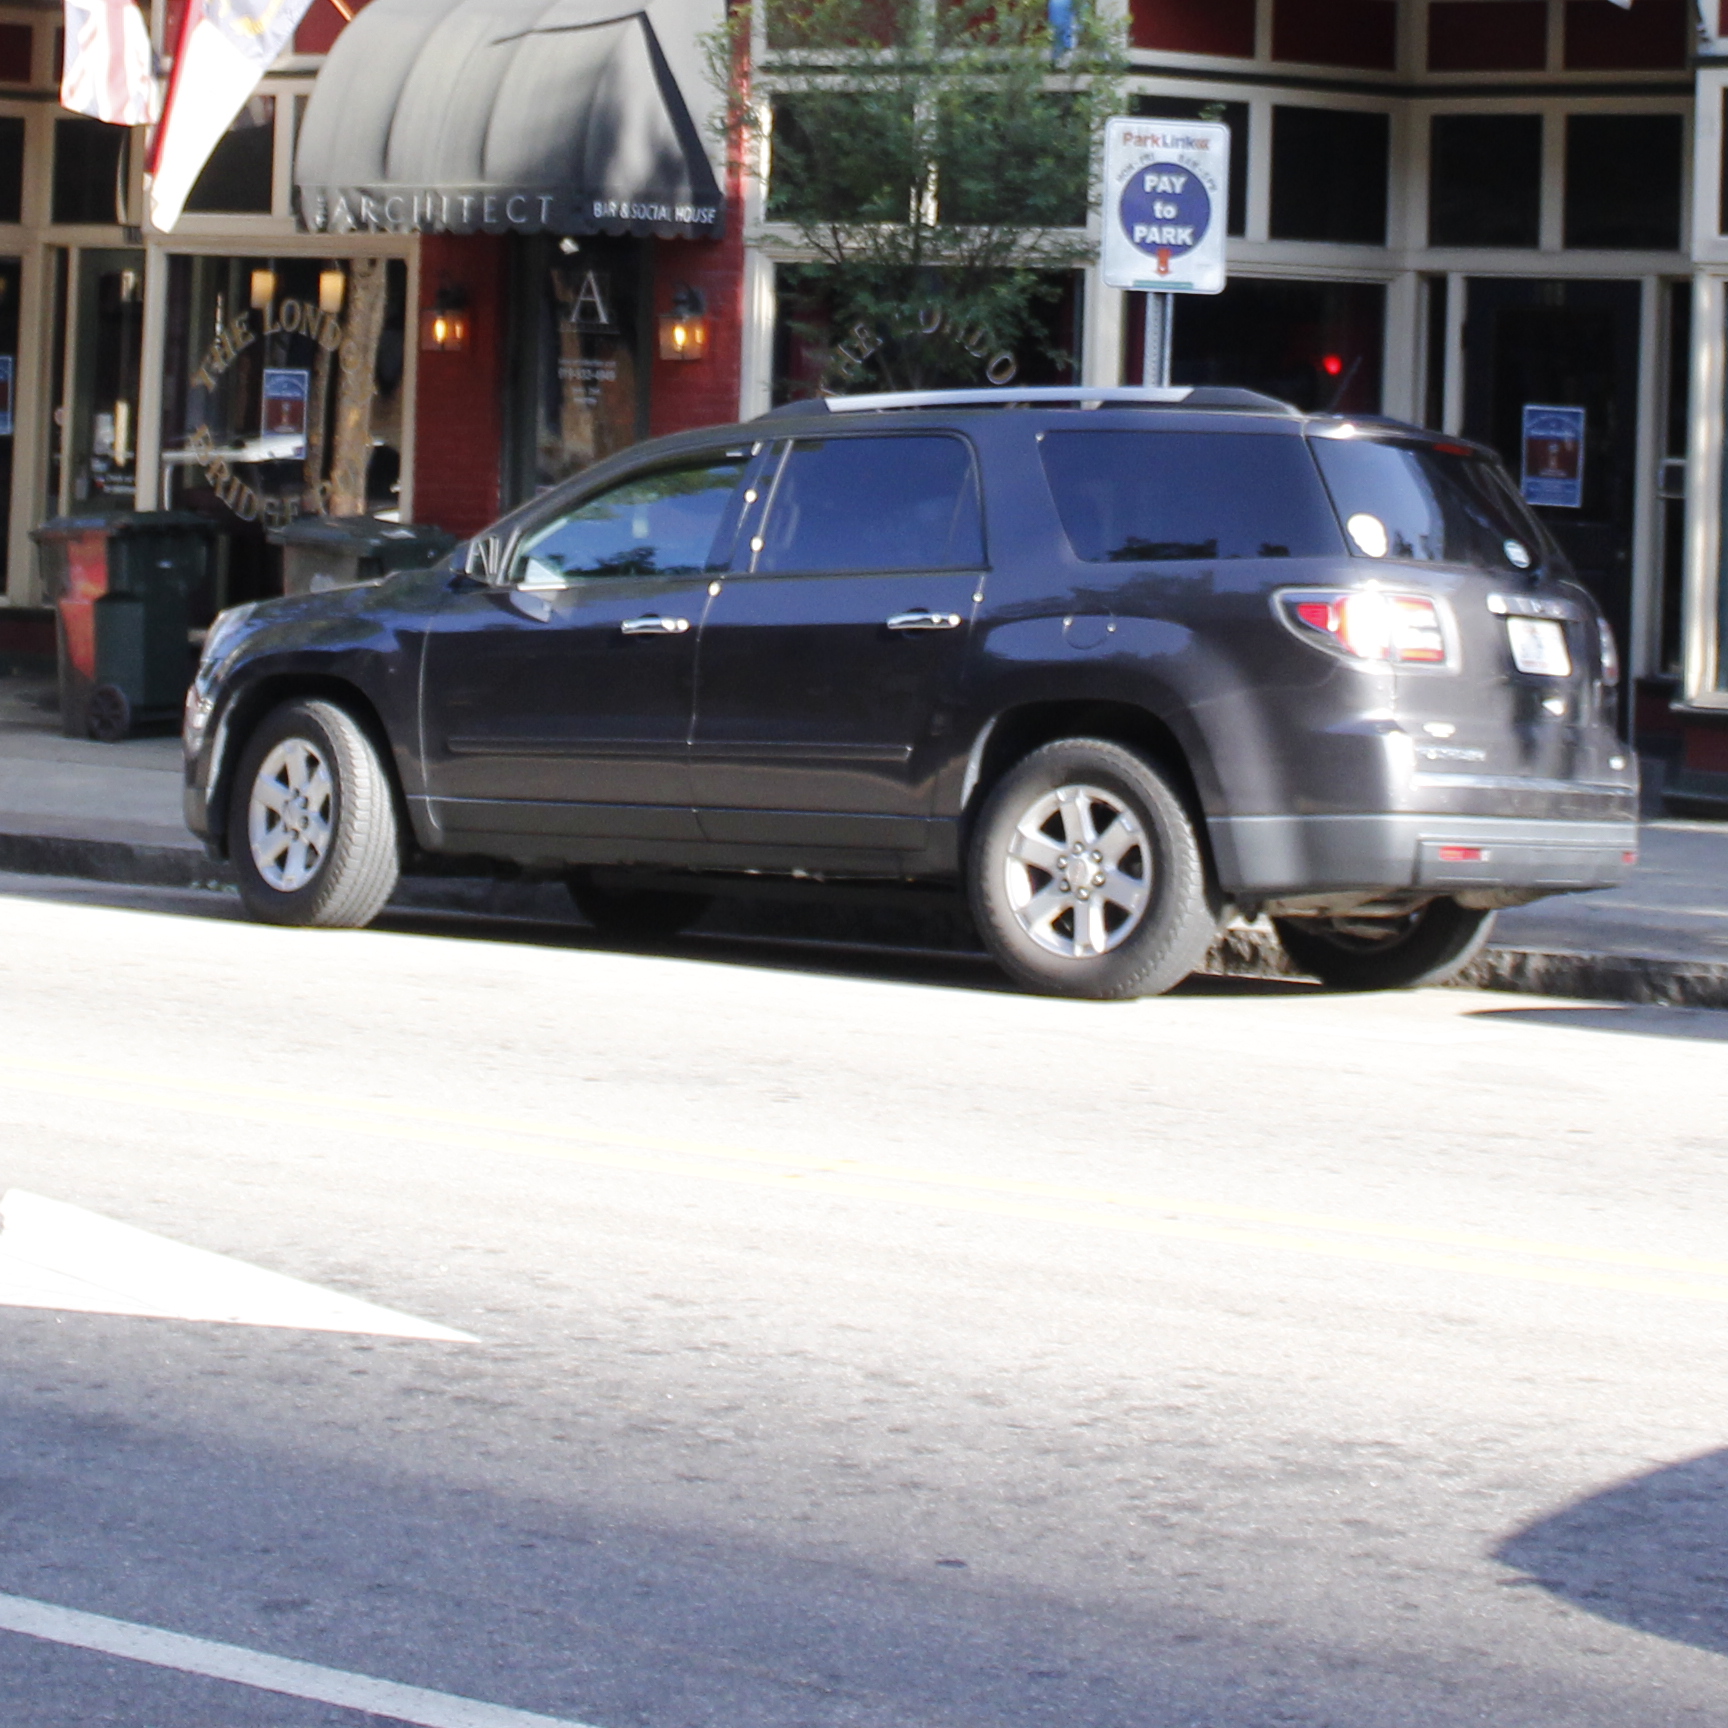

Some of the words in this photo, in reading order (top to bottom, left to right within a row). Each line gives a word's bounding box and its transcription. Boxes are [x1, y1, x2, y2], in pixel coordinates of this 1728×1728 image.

[1143, 172, 1188, 194] PAY
[332, 193, 554, 230] ARCHITECT
[592, 200, 618, 219] BAR
[630, 203, 672, 223] SOCIAL
[674, 204, 717, 224] HOUSE
[1152, 200, 1179, 220] to
[1132, 224, 1195, 246] PARK
[571, 270, 609, 325] A
[190, 311, 257, 393] THE
